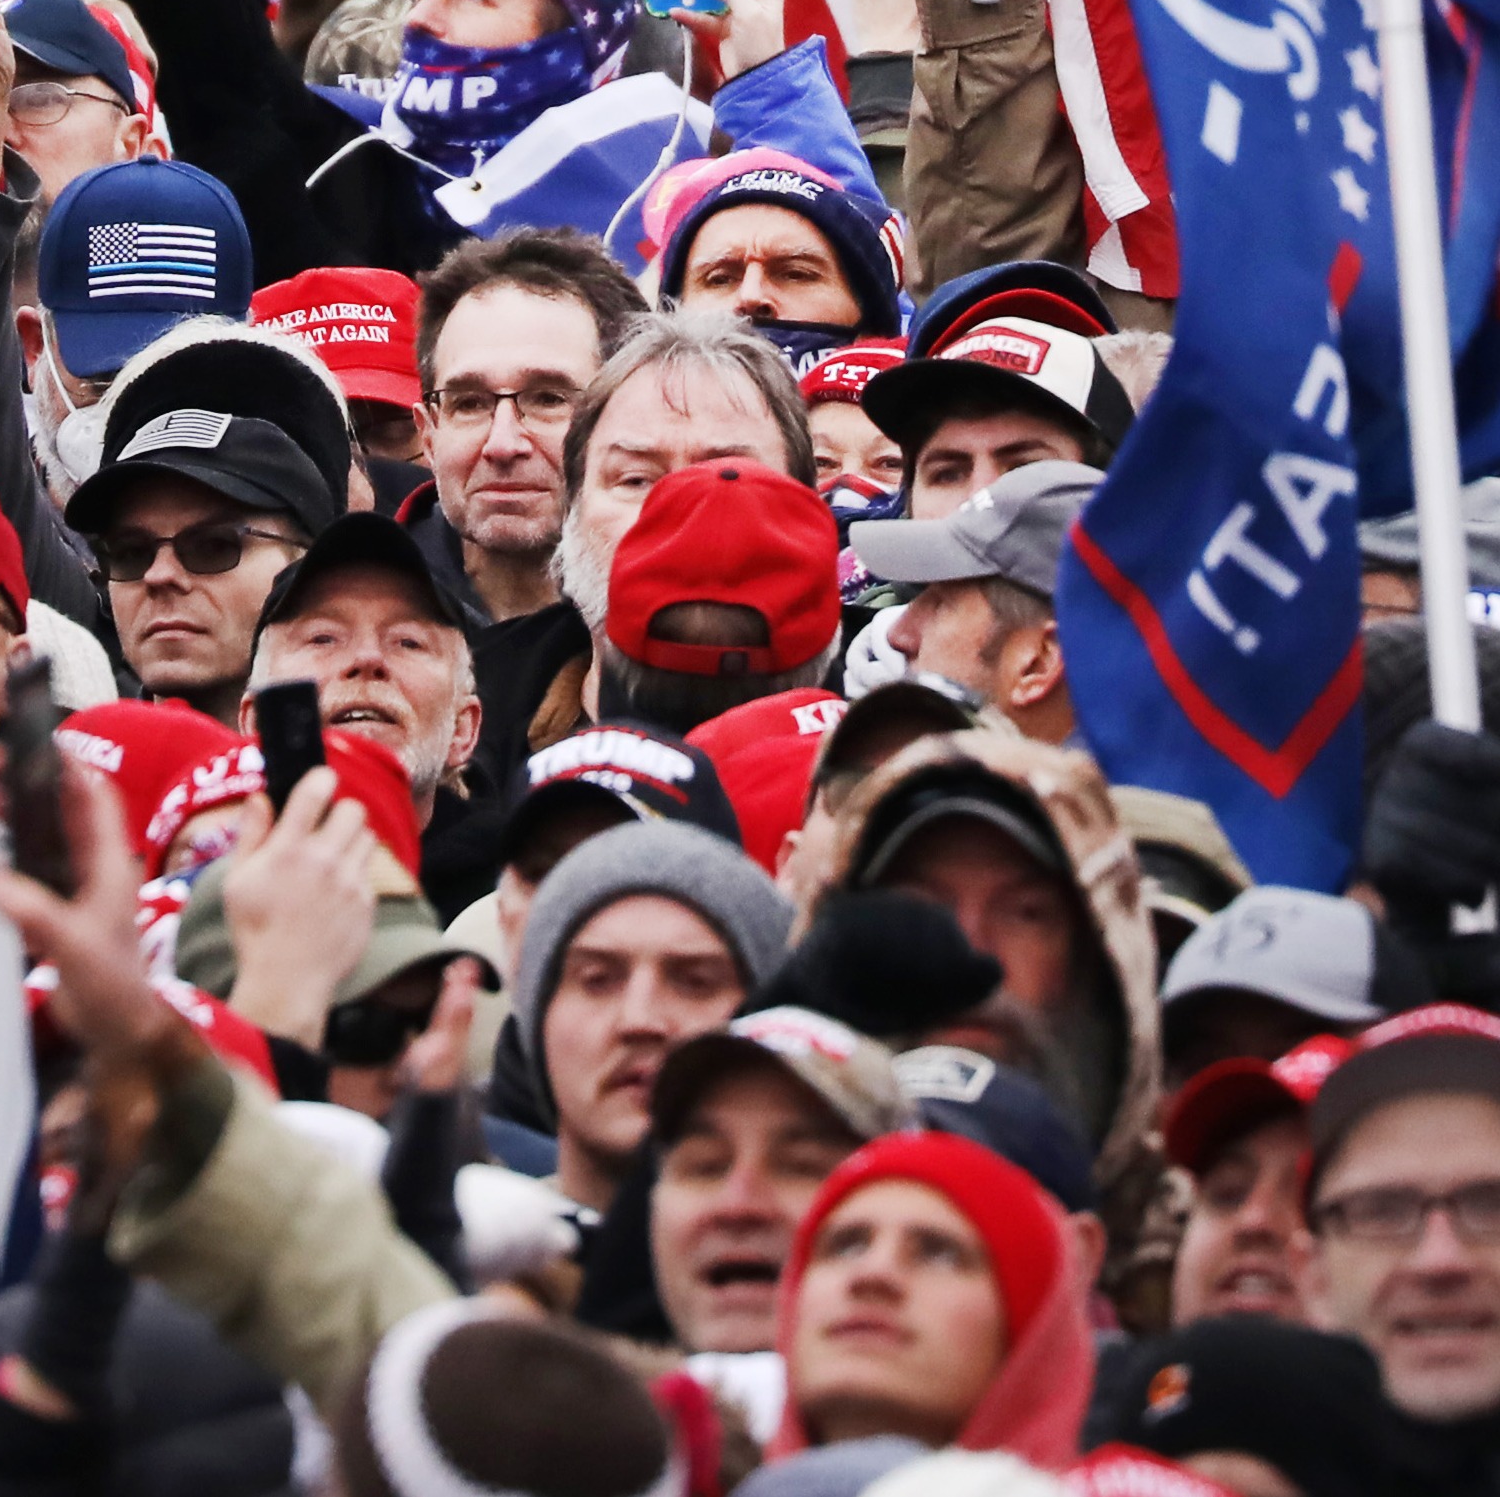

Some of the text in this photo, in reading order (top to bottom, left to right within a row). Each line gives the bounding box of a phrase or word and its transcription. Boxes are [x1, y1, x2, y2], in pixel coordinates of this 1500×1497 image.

[255, 303, 397, 330] MAKE AMERICA
[328, 324, 390, 343] AGAIN
